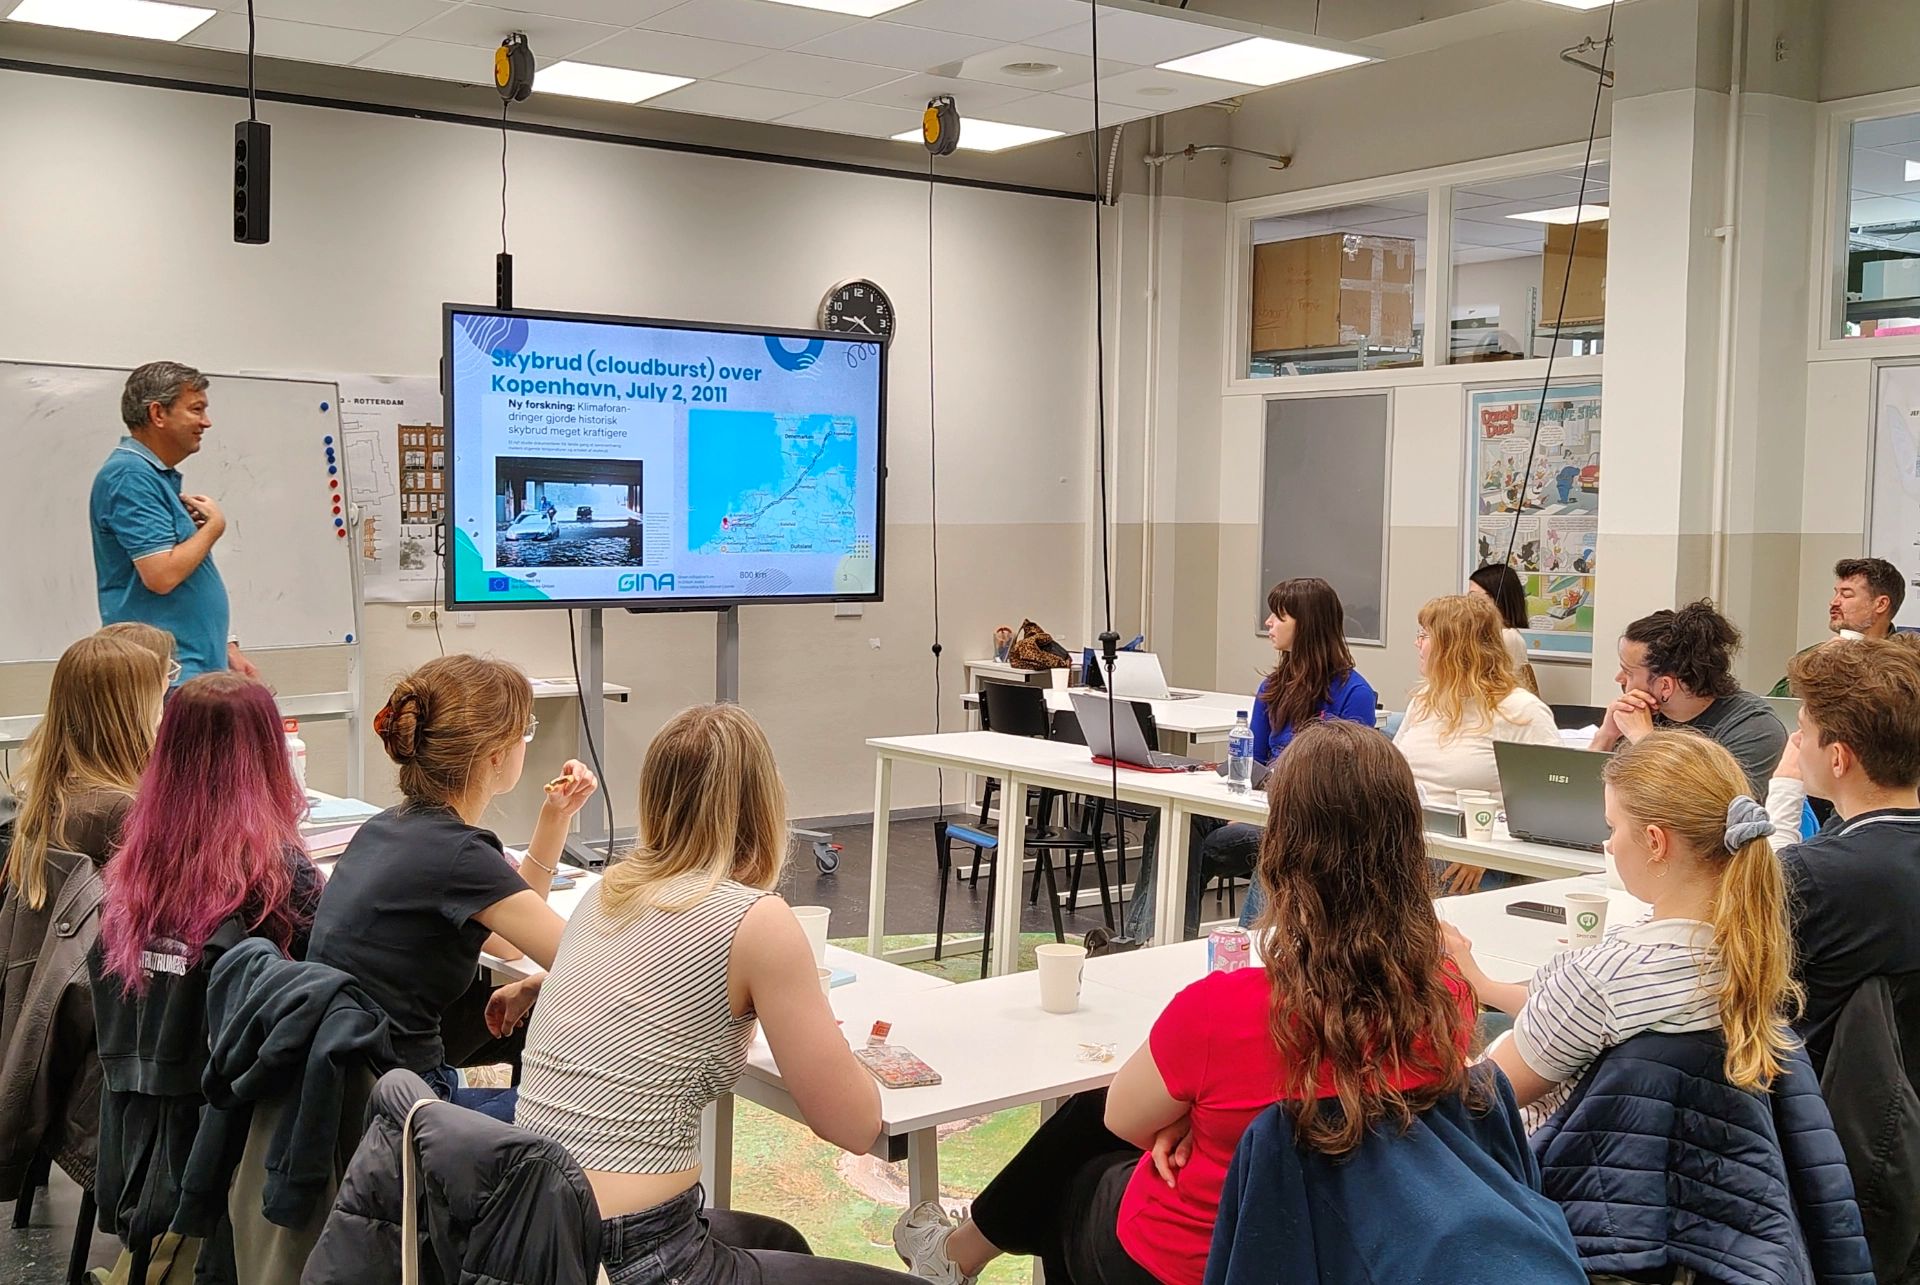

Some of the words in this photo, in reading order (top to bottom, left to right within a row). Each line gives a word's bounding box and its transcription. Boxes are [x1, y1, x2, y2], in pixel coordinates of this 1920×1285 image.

[843, 291, 849, 300] 11
[854, 288, 863, 297] 12
[870, 293, 874, 303] 1
[834, 302, 842, 311] 10
[876, 305, 883, 314] 2
[831, 315, 838, 324] 9
[880, 319, 886, 328] 3
[491, 349, 582, 374] Skybrud
[587, 349, 715, 382] (cloudburst)
[719, 366, 762, 381] over
[492, 374, 621, 401] Kopenhavn,
[626, 382, 668, 402] July
[672, 384, 687, 404] 2,
[691, 385, 727, 402] 2011
[508, 399, 523, 410] Ny
[526, 400, 575, 412] forskning:
[577, 402, 631, 413] Klimaforan-
[508, 412, 543, 423] dringer
[545, 414, 576, 424] gjorde
[579, 415, 618, 425] historisk
[508, 425, 548, 436] skybrud
[550, 427, 580, 438] meget
[583, 427, 628, 439] kraftigere
[618, 573, 674, 592] GINA
